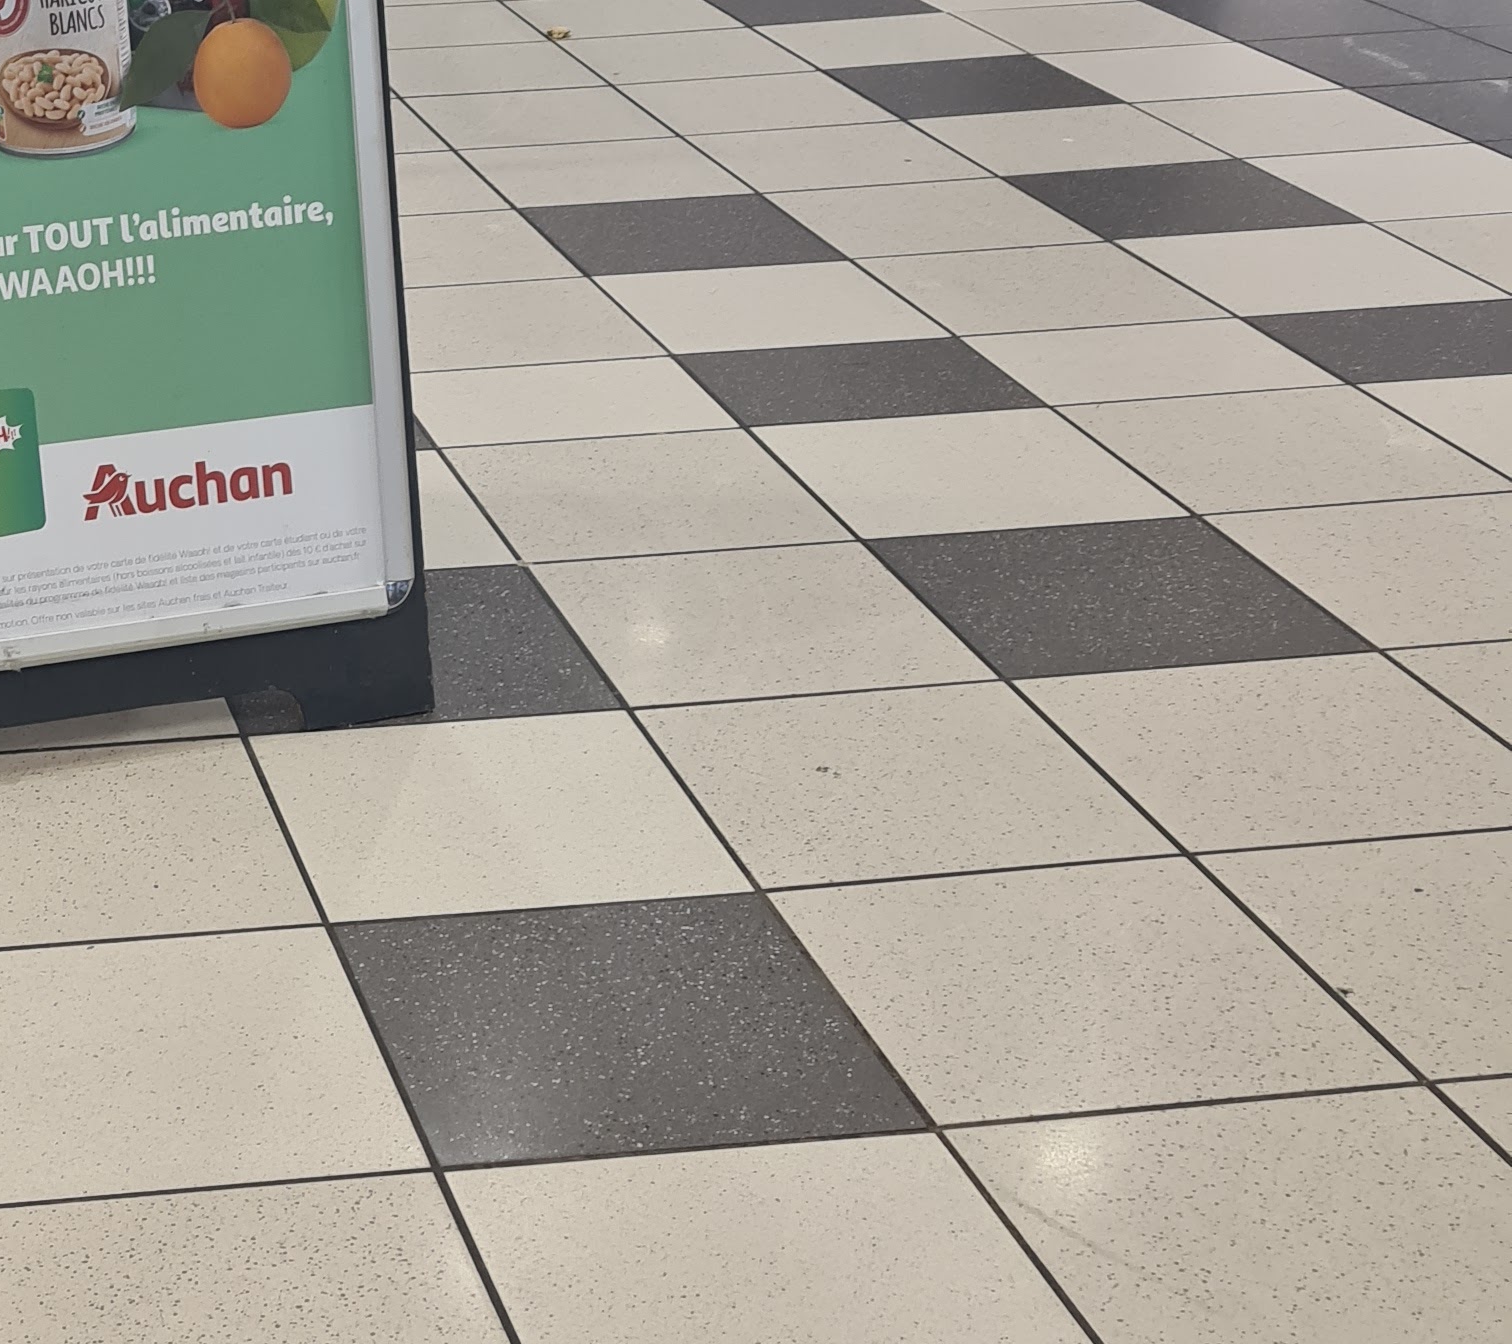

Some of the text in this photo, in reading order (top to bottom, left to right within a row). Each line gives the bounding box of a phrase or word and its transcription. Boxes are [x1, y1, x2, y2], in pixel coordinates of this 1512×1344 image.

[49, 4, 105, 36] BLANCS
[23, 216, 113, 254] TOUT
[120, 194, 334, 243] l'alimentaire,
[83, 461, 294, 522] Auchan
